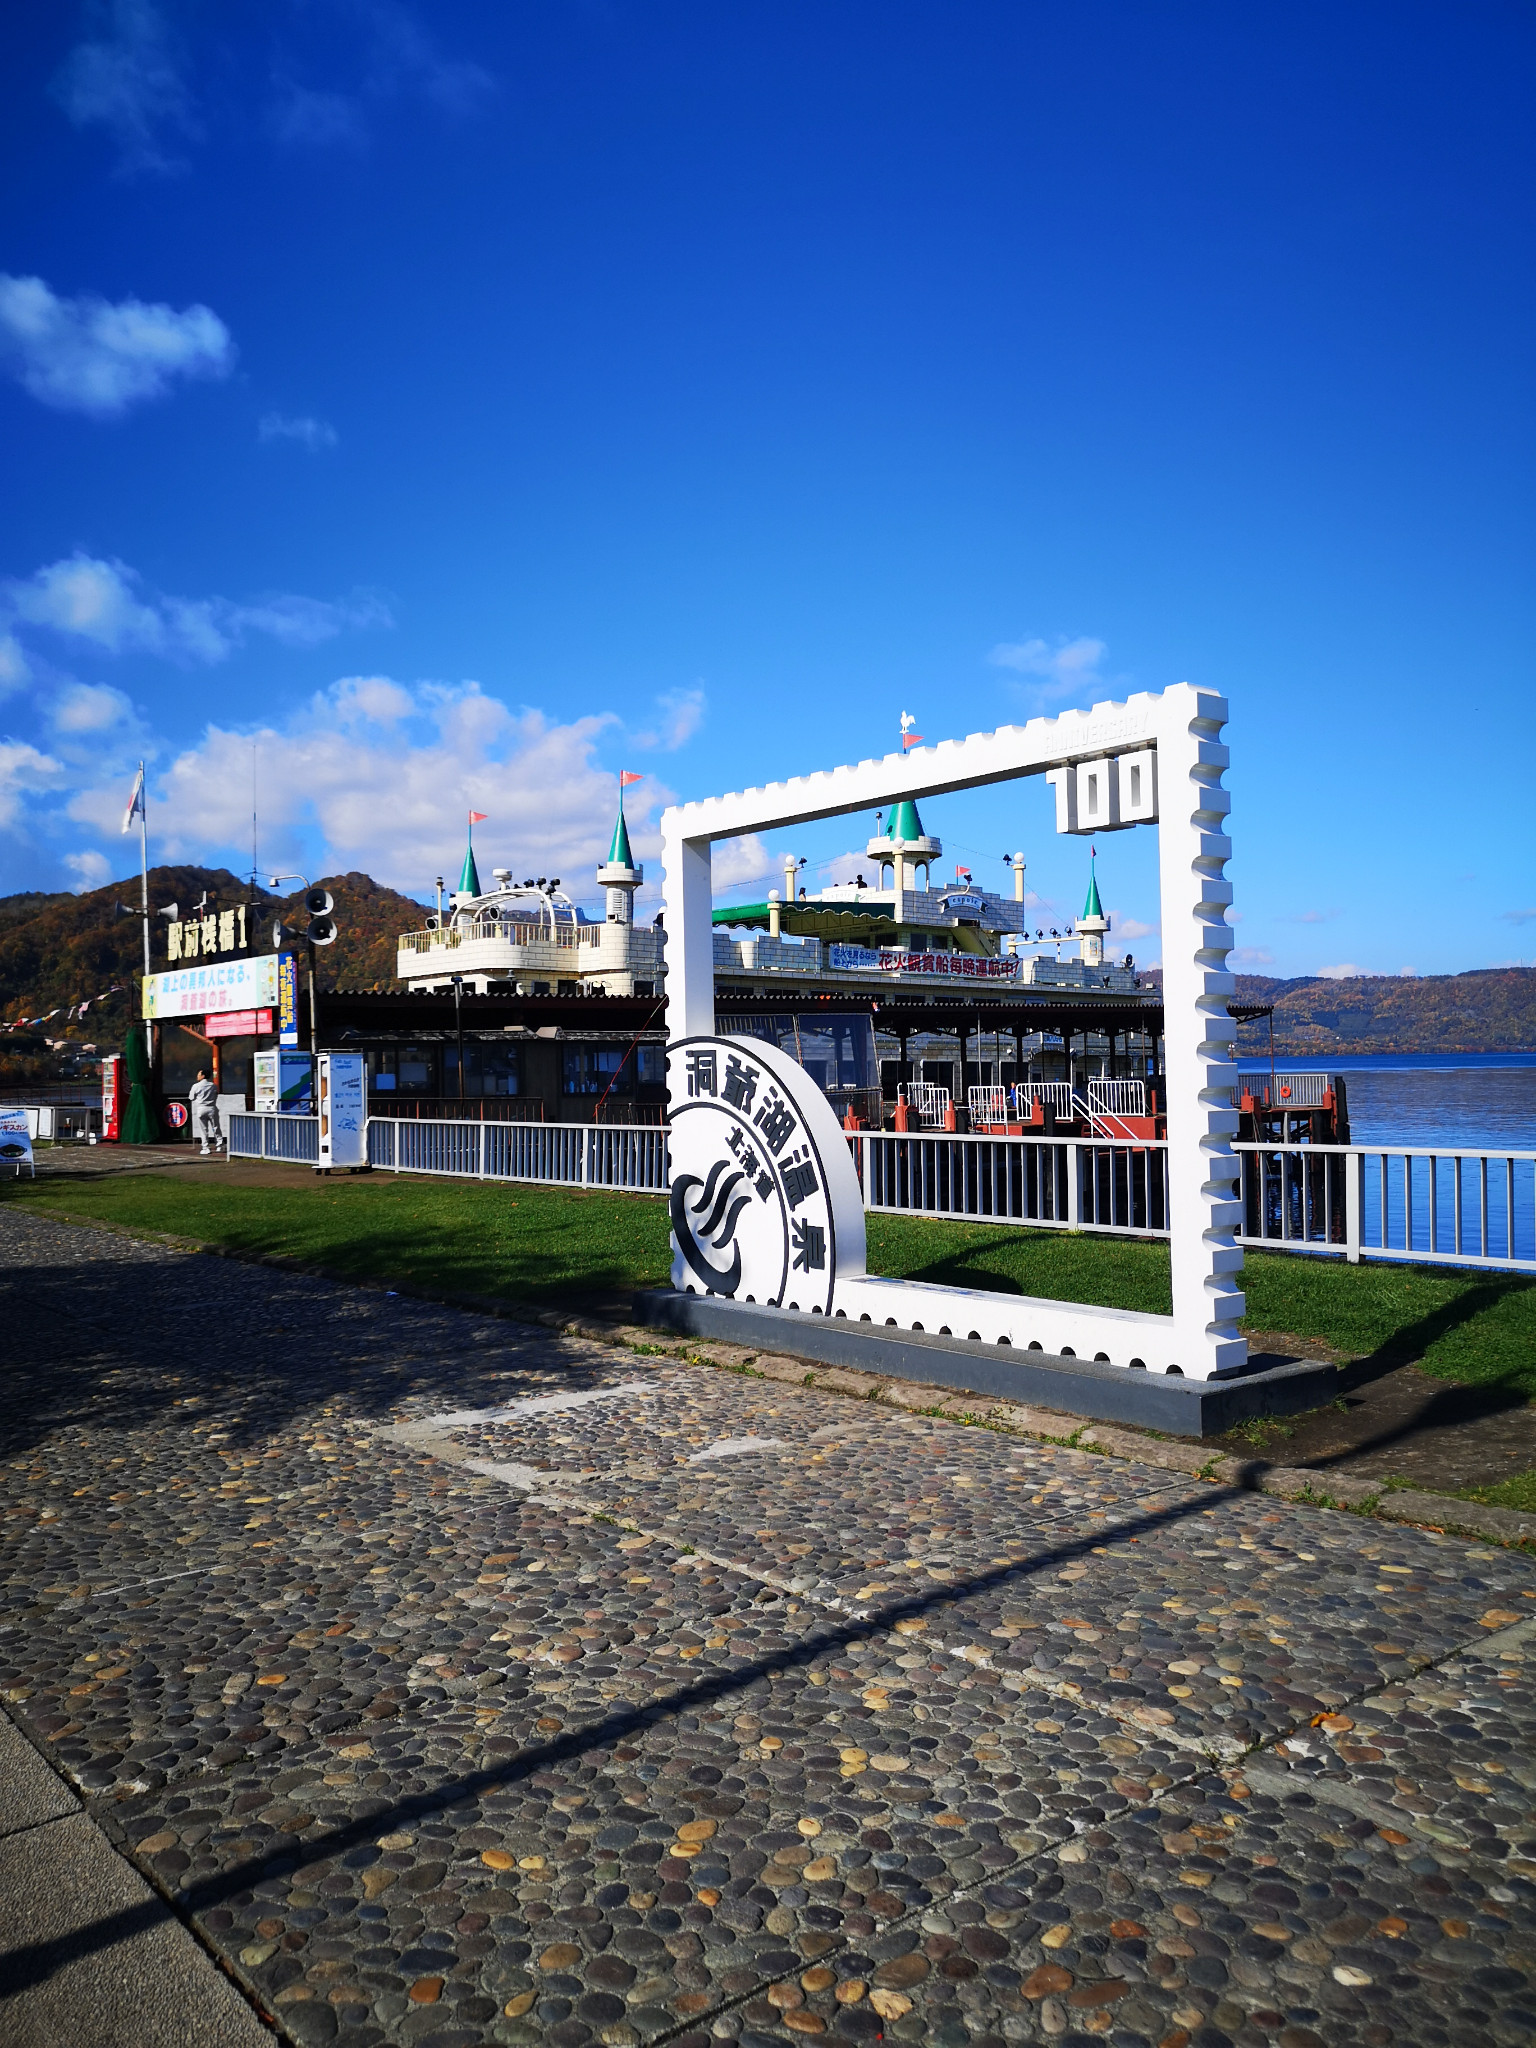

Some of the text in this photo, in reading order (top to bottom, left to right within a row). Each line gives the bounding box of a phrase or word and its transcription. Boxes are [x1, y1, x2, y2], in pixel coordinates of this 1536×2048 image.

[1043, 711, 1148, 754] ANNIVERSARY
[1046, 749, 1157, 834] 100
[833, 948, 877, 961] 花火を見るなら
[686, 1049, 827, 1274] 洞爺湖温泉
[725, 1126, 775, 1203] 北海道
